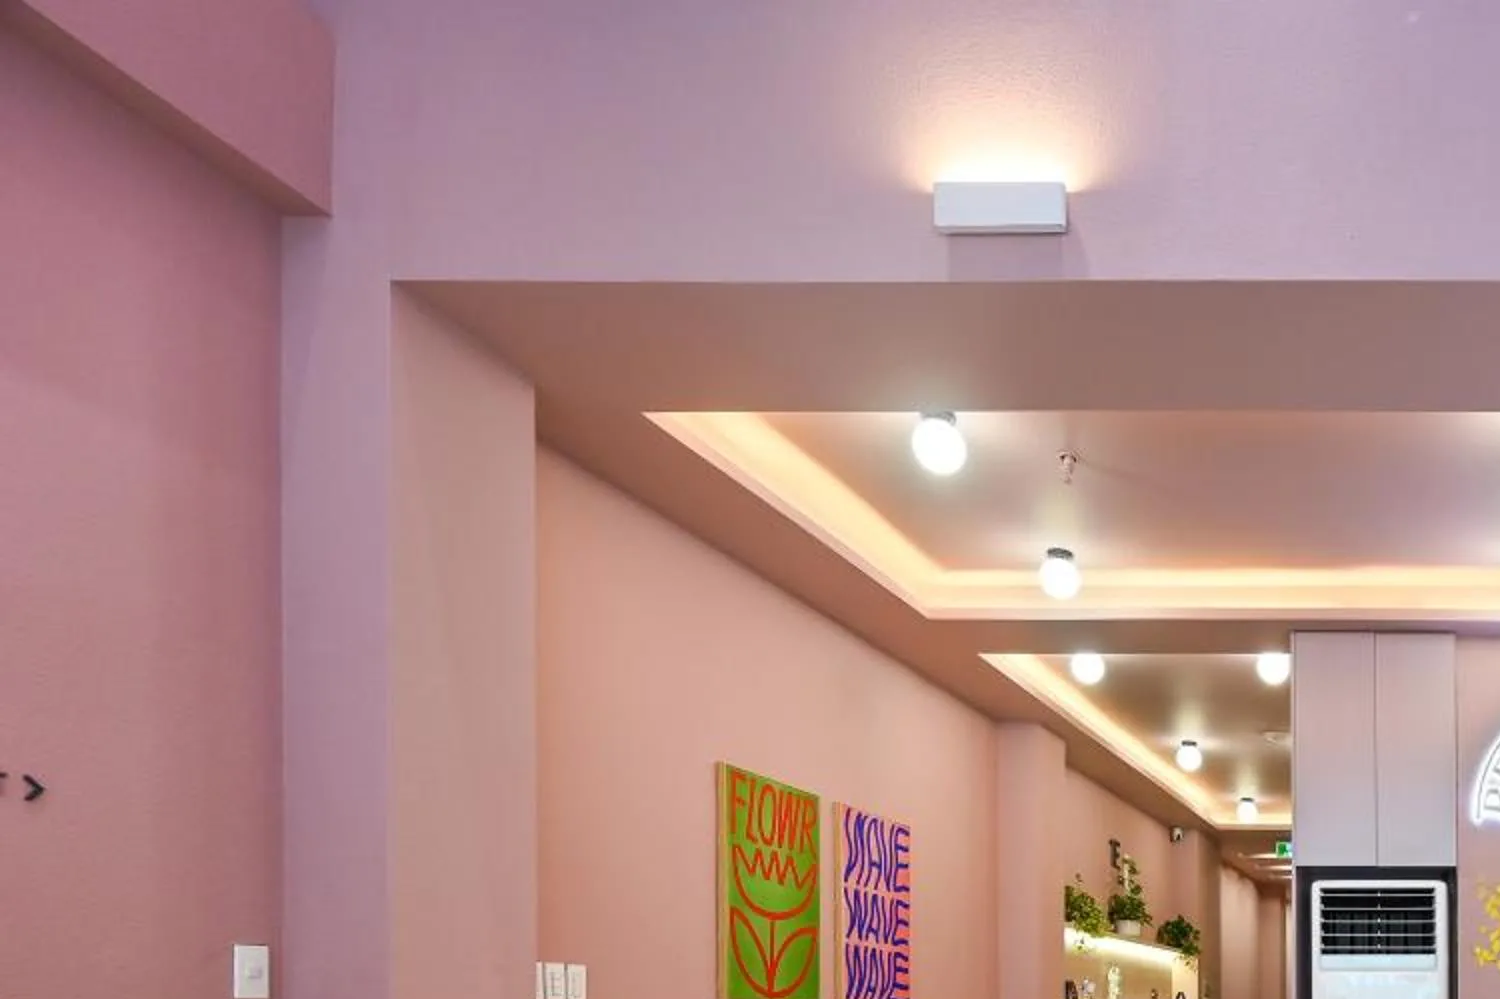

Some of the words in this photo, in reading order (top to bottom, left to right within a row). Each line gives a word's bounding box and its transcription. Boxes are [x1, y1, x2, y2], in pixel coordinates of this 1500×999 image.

[730, 769, 818, 863] FLOWR
[843, 806, 911, 893] WAVE
[843, 886, 911, 947] WAVE
